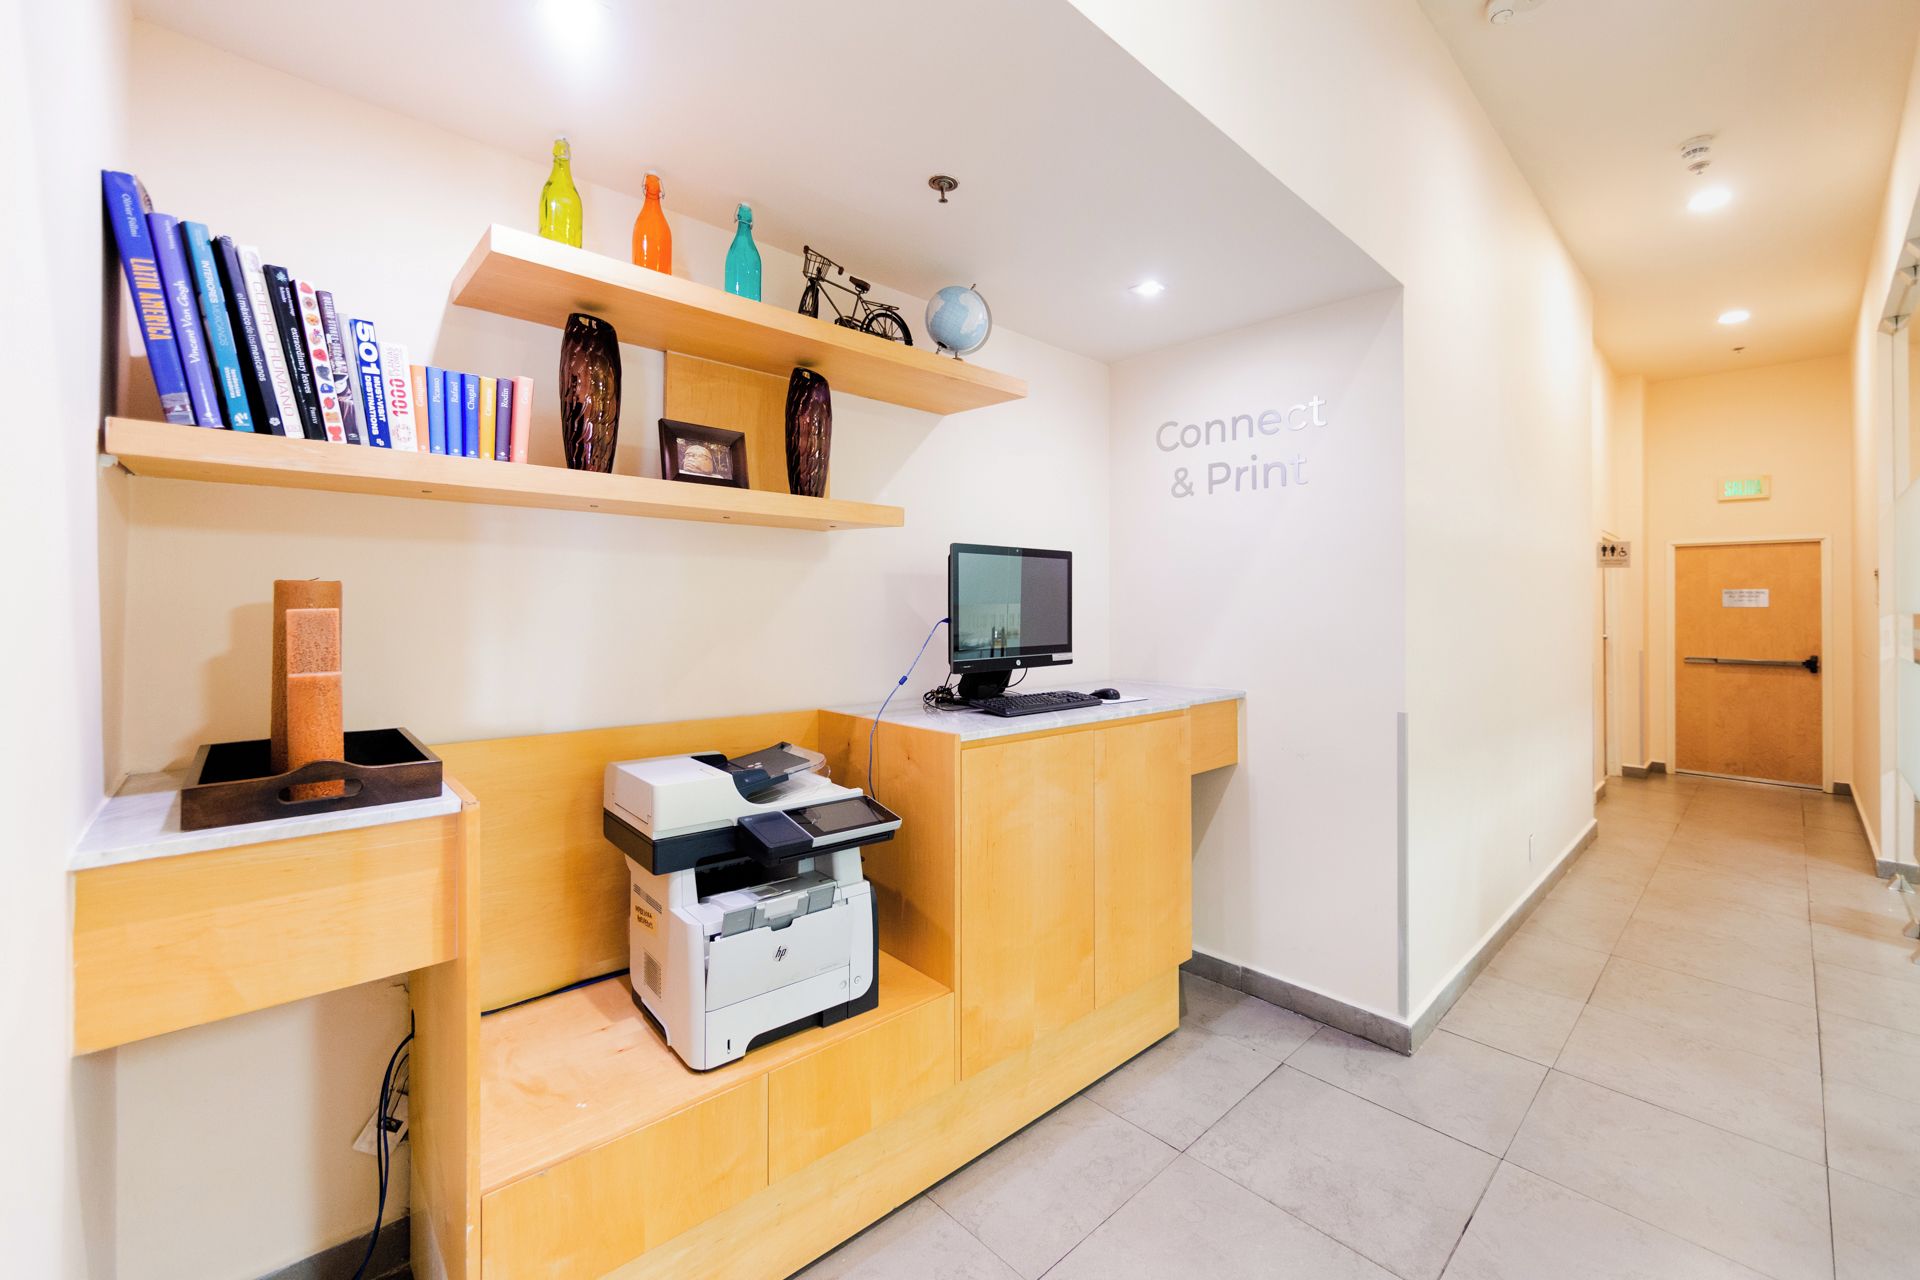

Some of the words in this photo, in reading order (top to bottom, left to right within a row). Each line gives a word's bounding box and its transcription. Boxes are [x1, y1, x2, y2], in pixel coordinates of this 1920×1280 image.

[130, 258, 160, 290] LATIN
[172, 280, 189, 307] Gogh
[201, 260, 218, 304] INTERIORES
[138, 290, 173, 341] AMERICA
[182, 305, 193, 329] Van
[188, 328, 201, 364] Vincent
[253, 281, 276, 344] CUERPO
[270, 346, 294, 417] HUMANO
[290, 327, 307, 372] extraordinary
[300, 371, 312, 394] leaves
[356, 321, 381, 375] 501
[364, 375, 380, 436] DESTINATIONS
[372, 375, 387, 423] MUST-VISIT
[389, 378, 409, 417] 1000
[432, 377, 441, 404] Picasso
[452, 380, 460, 404] Rafael
[467, 383, 478, 411] Chagall
[501, 387, 509, 409] Rodin
[1155, 394, 1328, 452] Connect
[1170, 467, 1195, 499] &
[1207, 453, 1310, 496] Print
[774, 945, 788, 963] hp
